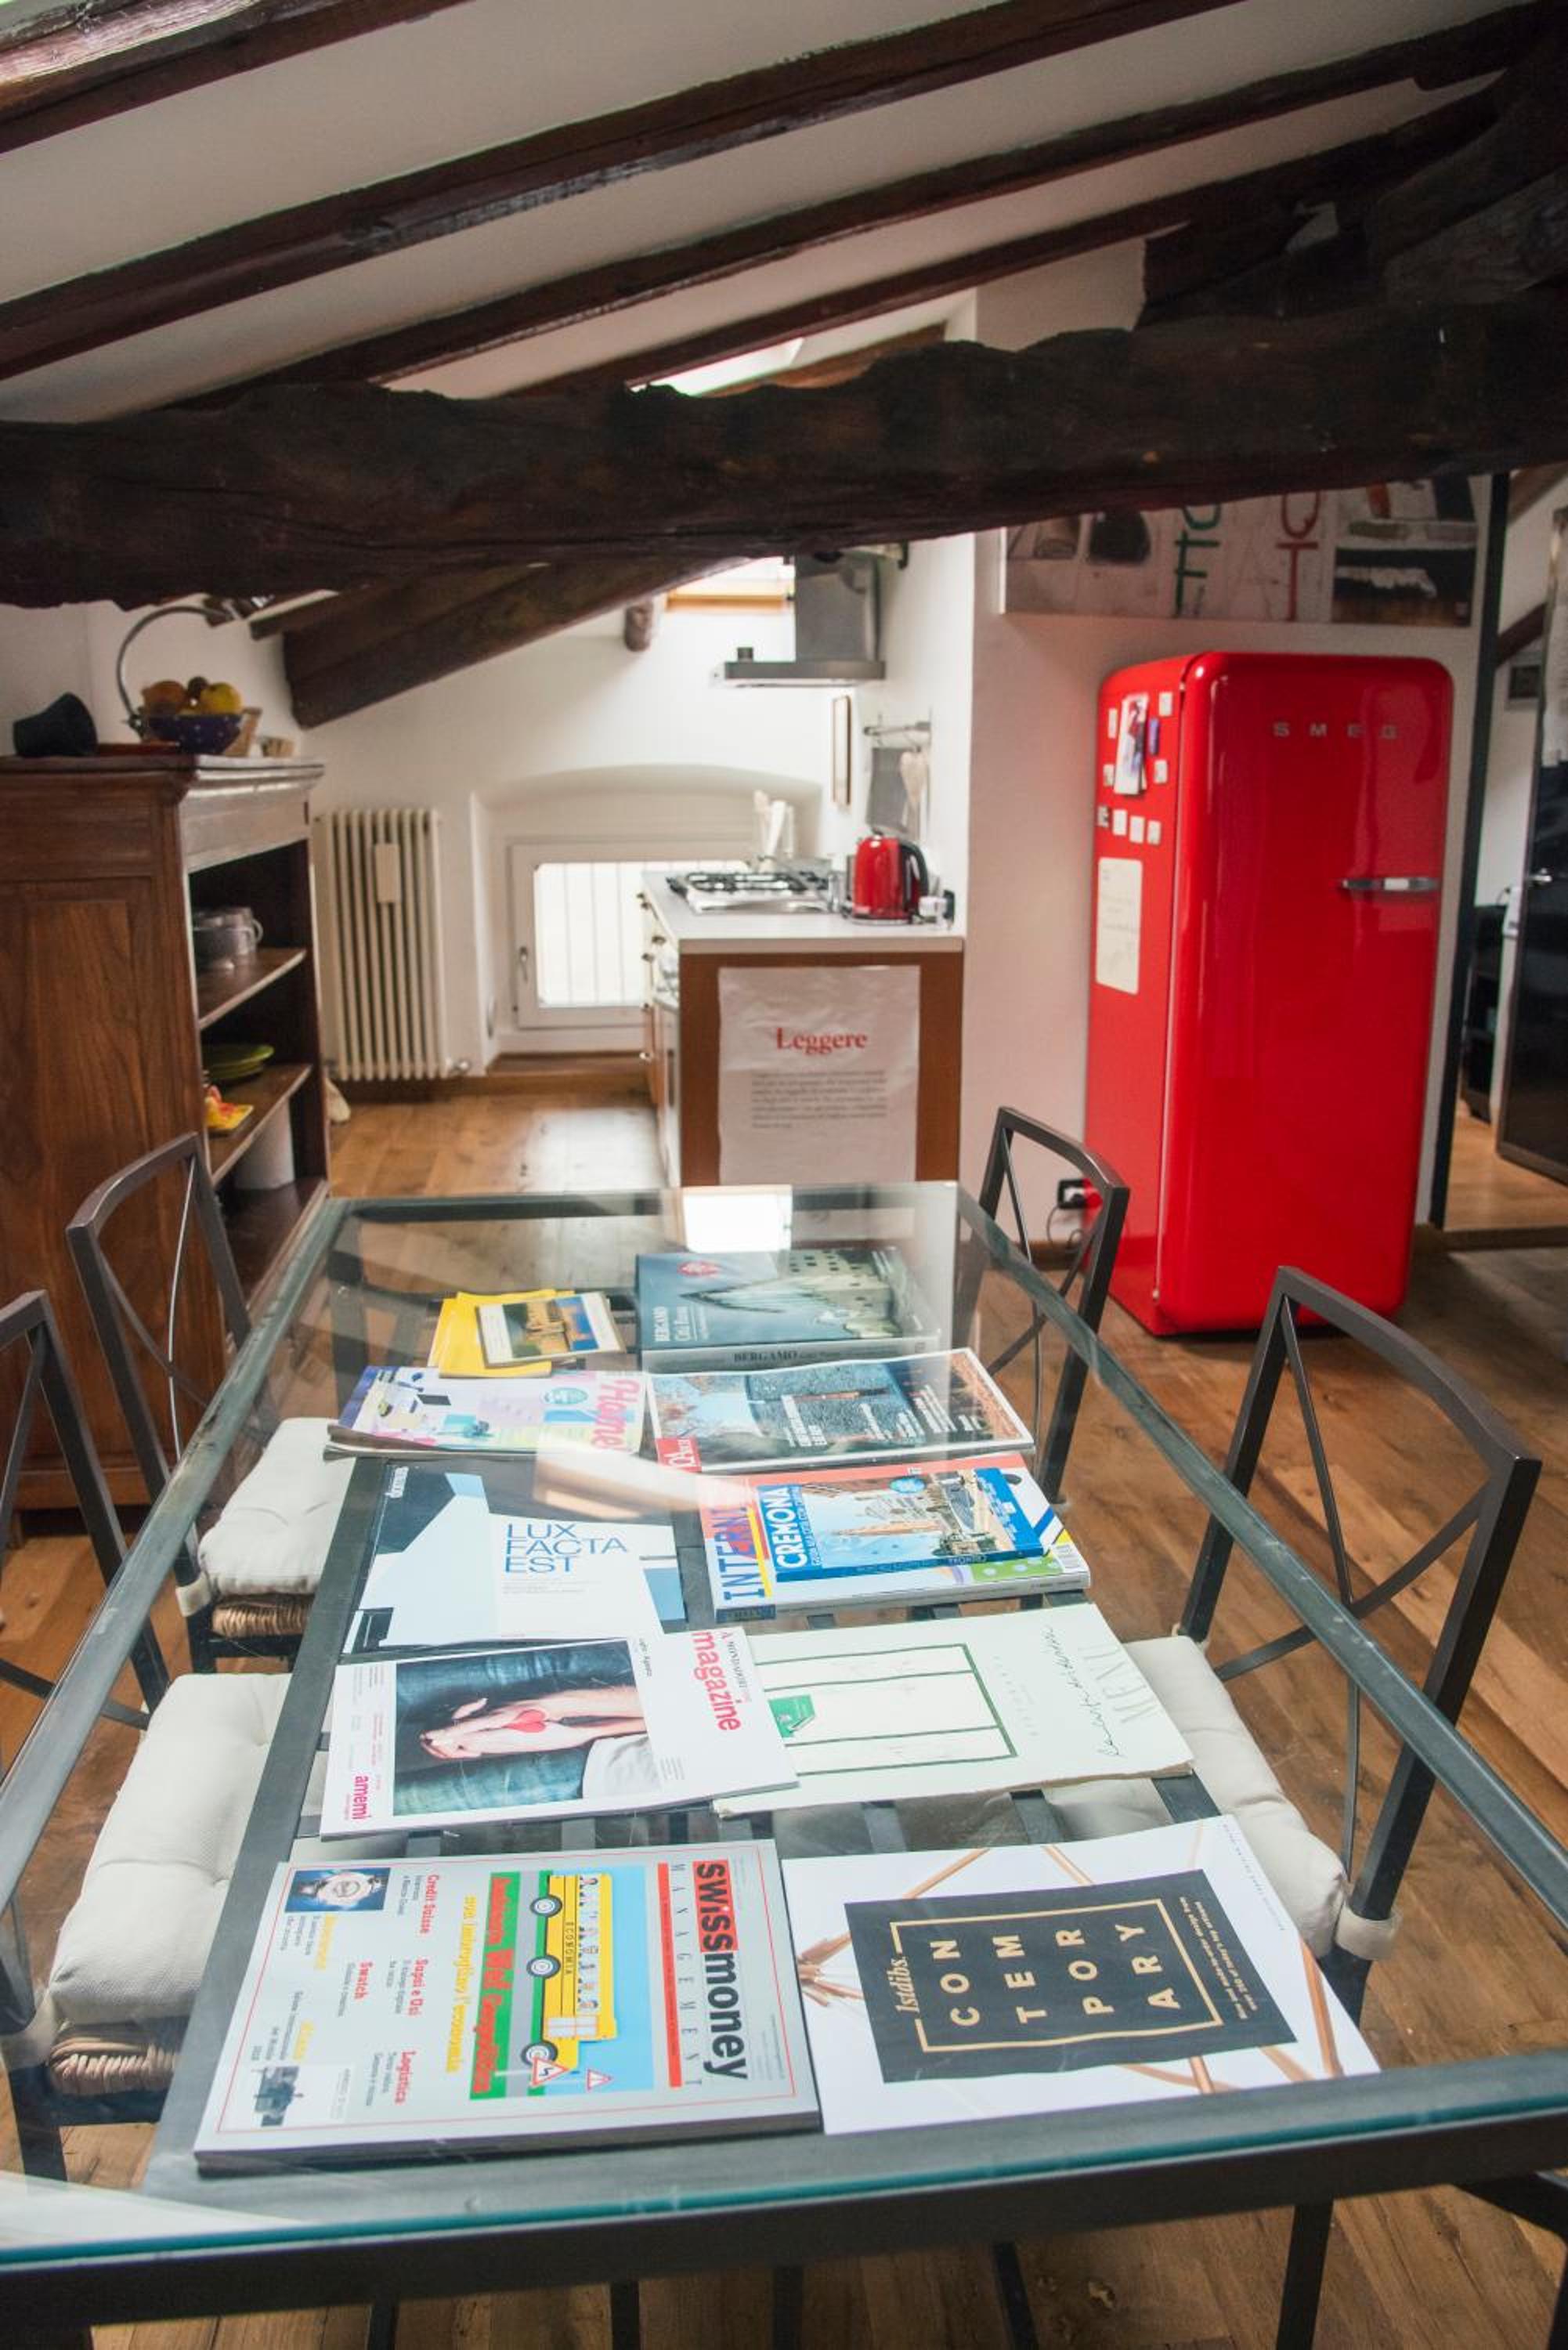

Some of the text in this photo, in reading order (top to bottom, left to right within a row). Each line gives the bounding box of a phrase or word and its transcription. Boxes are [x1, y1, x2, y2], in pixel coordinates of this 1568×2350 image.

[1272, 721, 1398, 739] SMEG
[776, 1028, 868, 1055] Leggere
[733, 1349, 798, 1363] BERGAMO
[505, 1536, 627, 1556] FACTA
[508, 1523, 577, 1539] LUX
[763, 1487, 808, 1568] CREMONA
[504, 1556, 582, 1574] EST
[691, 1631, 742, 1732] magazine
[352, 1775, 370, 1820] amemi
[419, 1874, 439, 1934] Credit Suisse
[564, 1921, 575, 1975] ECONOMIA
[354, 1961, 374, 2001] Swatch
[670, 1863, 703, 2085] MANAGEMENT
[394, 2050, 416, 2105] Logistica
